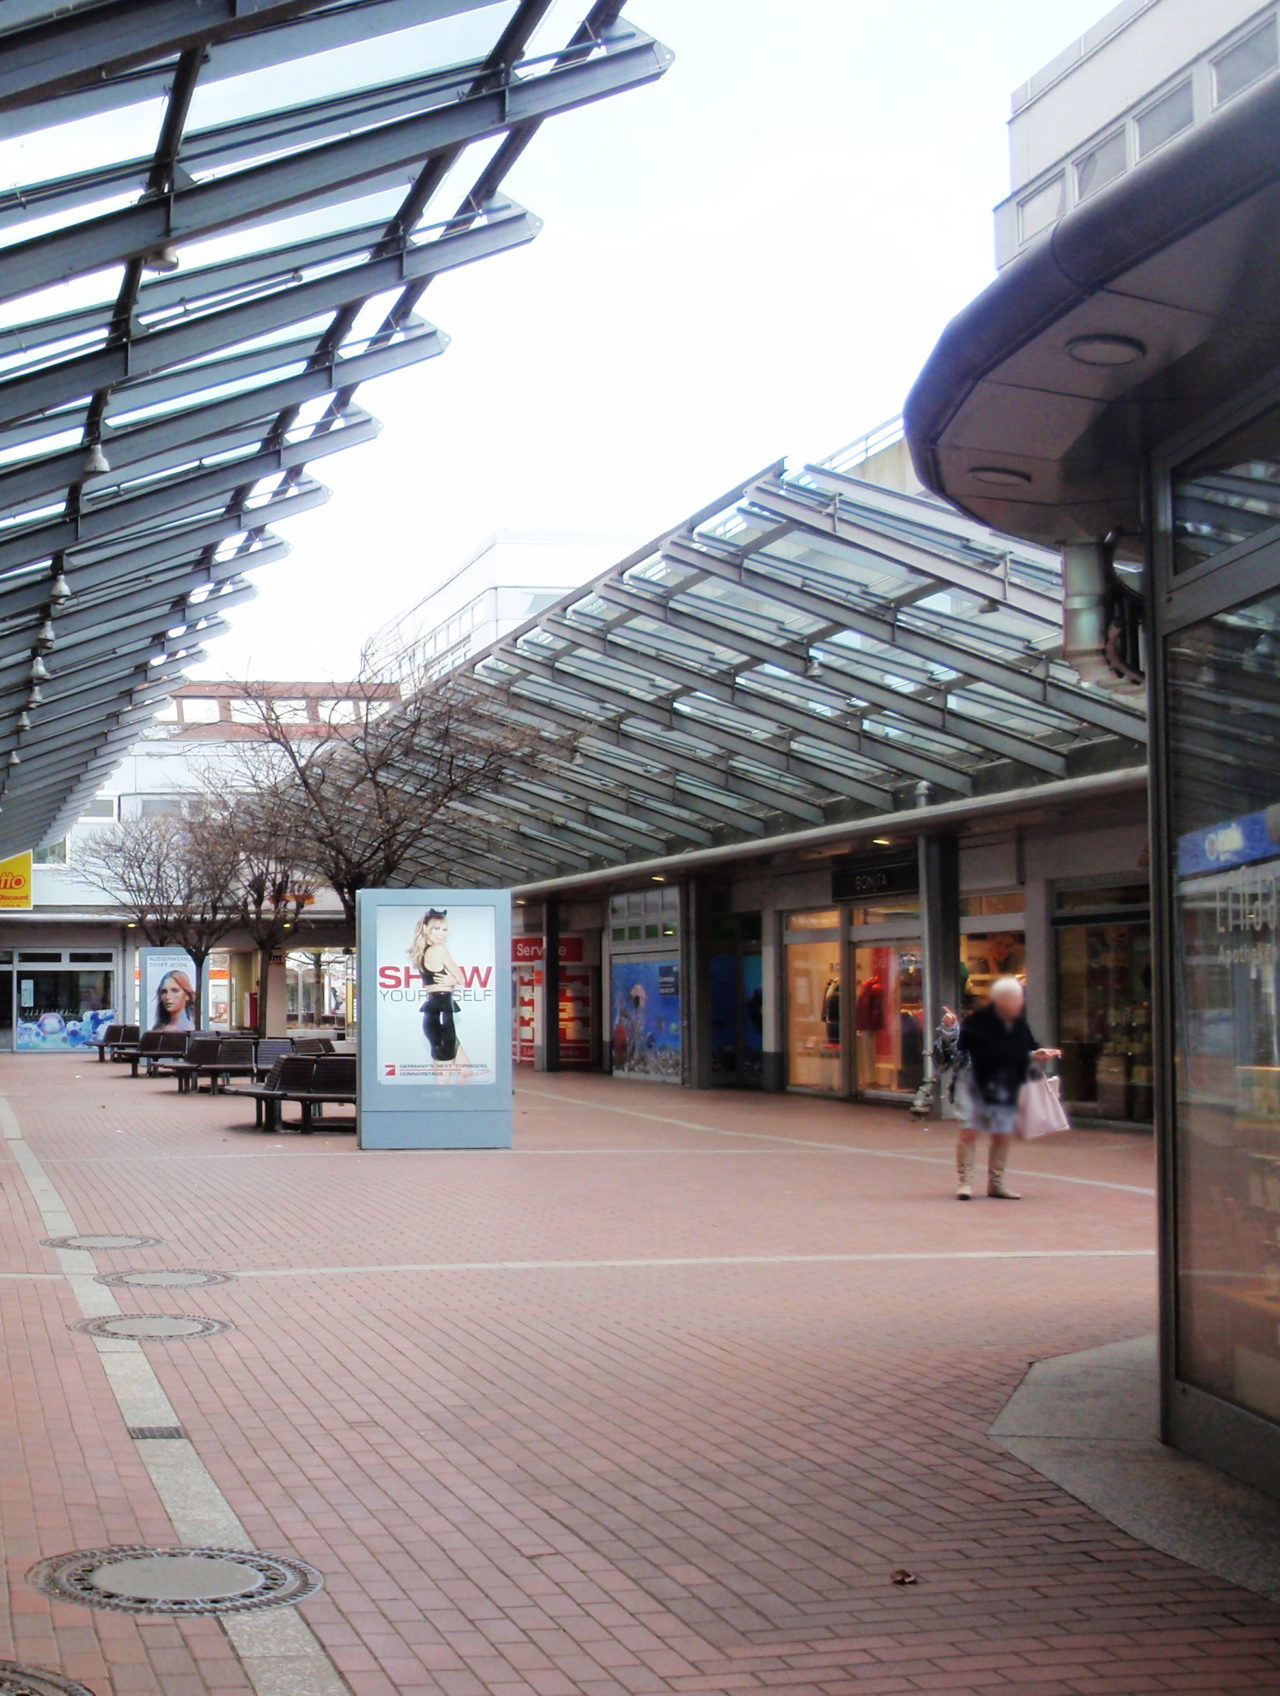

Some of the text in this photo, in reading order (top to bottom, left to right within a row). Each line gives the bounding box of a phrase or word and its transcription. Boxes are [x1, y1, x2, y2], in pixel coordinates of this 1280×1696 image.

[855, 873, 888, 891] BONITA
[516, 943, 568, 957] Serve
[378, 965, 493, 989] SHW
